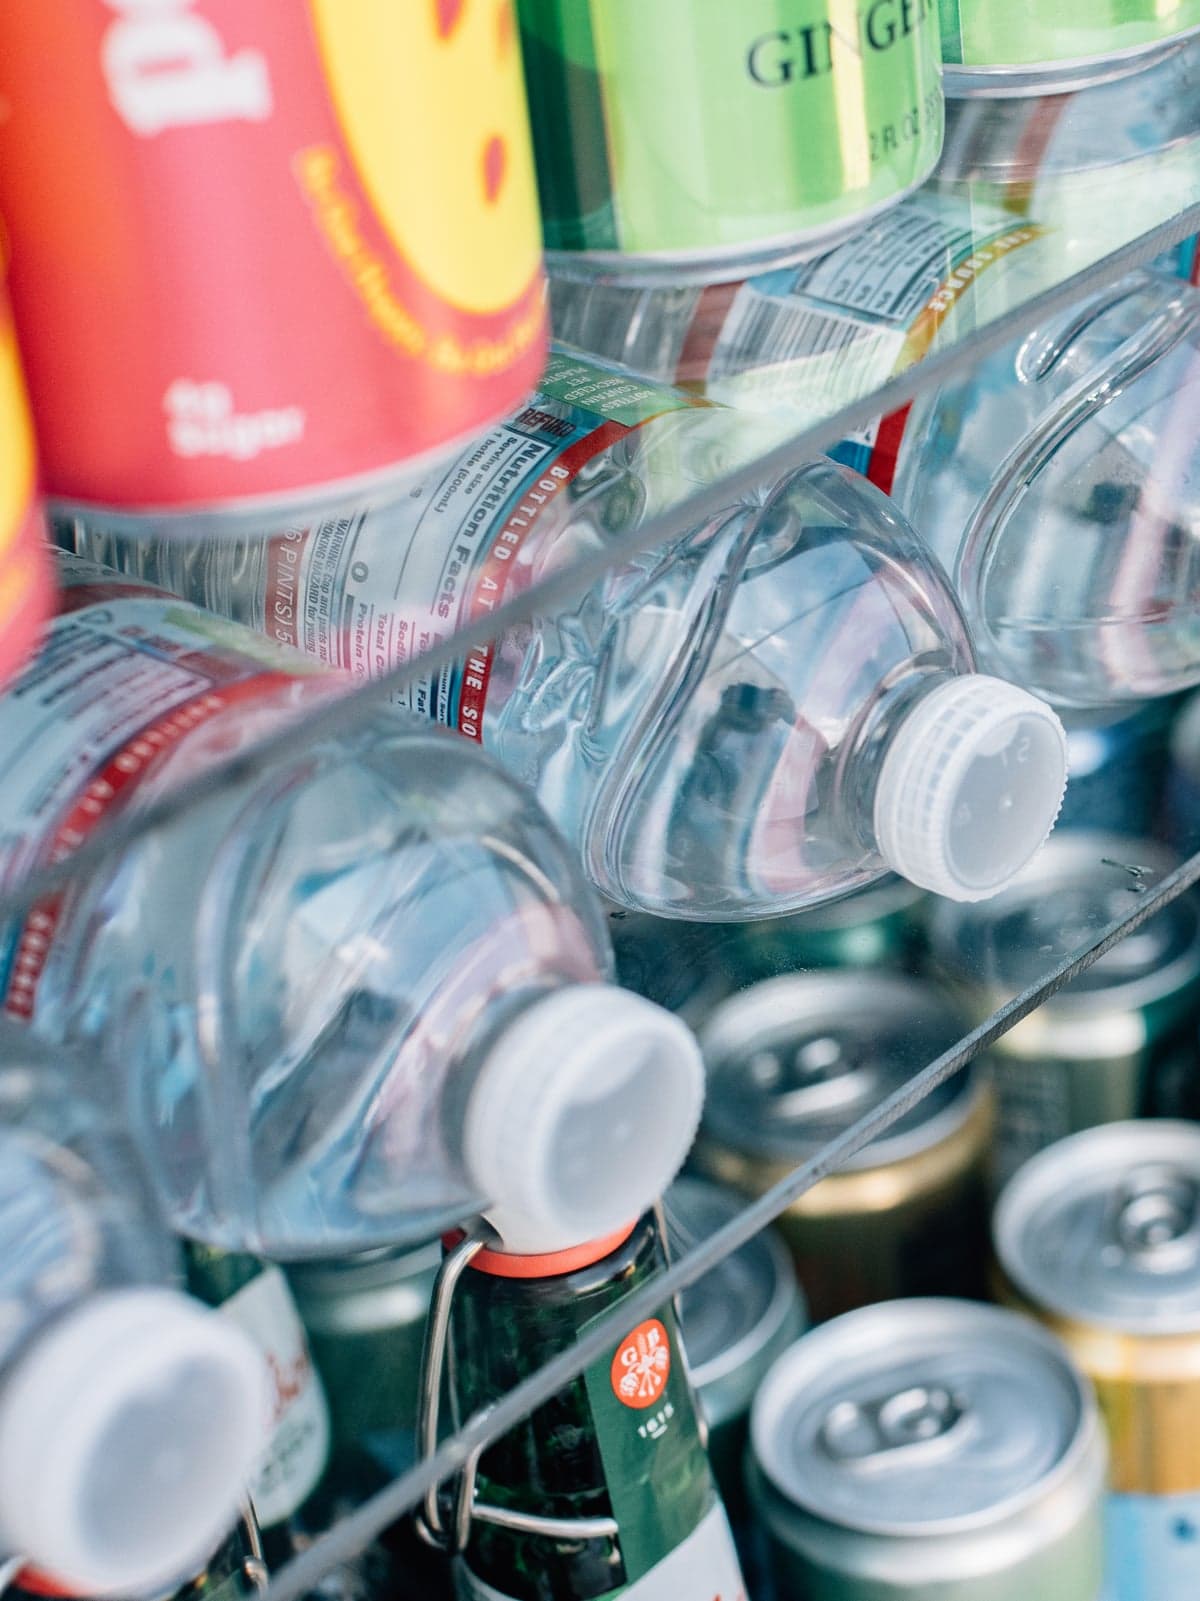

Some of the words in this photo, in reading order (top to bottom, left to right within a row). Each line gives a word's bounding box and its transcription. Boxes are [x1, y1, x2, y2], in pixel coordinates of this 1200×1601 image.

[466, 438, 496, 467] bottle
[481, 437, 518, 473] Serving
[433, 463, 470, 513] (500mL)
[463, 443, 545, 538] Nutrition
[464, 474, 484, 495] size
[493, 465, 570, 561] BOTTLED
[315, 522, 334, 558] HOKING
[325, 521, 348, 571] WARNING:
[274, 547, 297, 624] PINTS)
[308, 560, 321, 603] HAZARD
[320, 573, 332, 593] Cap
[438, 545, 471, 618] Facts
[478, 576, 499, 611] AT
[308, 605, 316, 619] for
[318, 595, 329, 615] and
[305, 622, 316, 652] young
[355, 603, 367, 658] Protein
[376, 614, 387, 650] Total
[466, 645, 489, 691] THE
[417, 688, 426, 713] Fat
